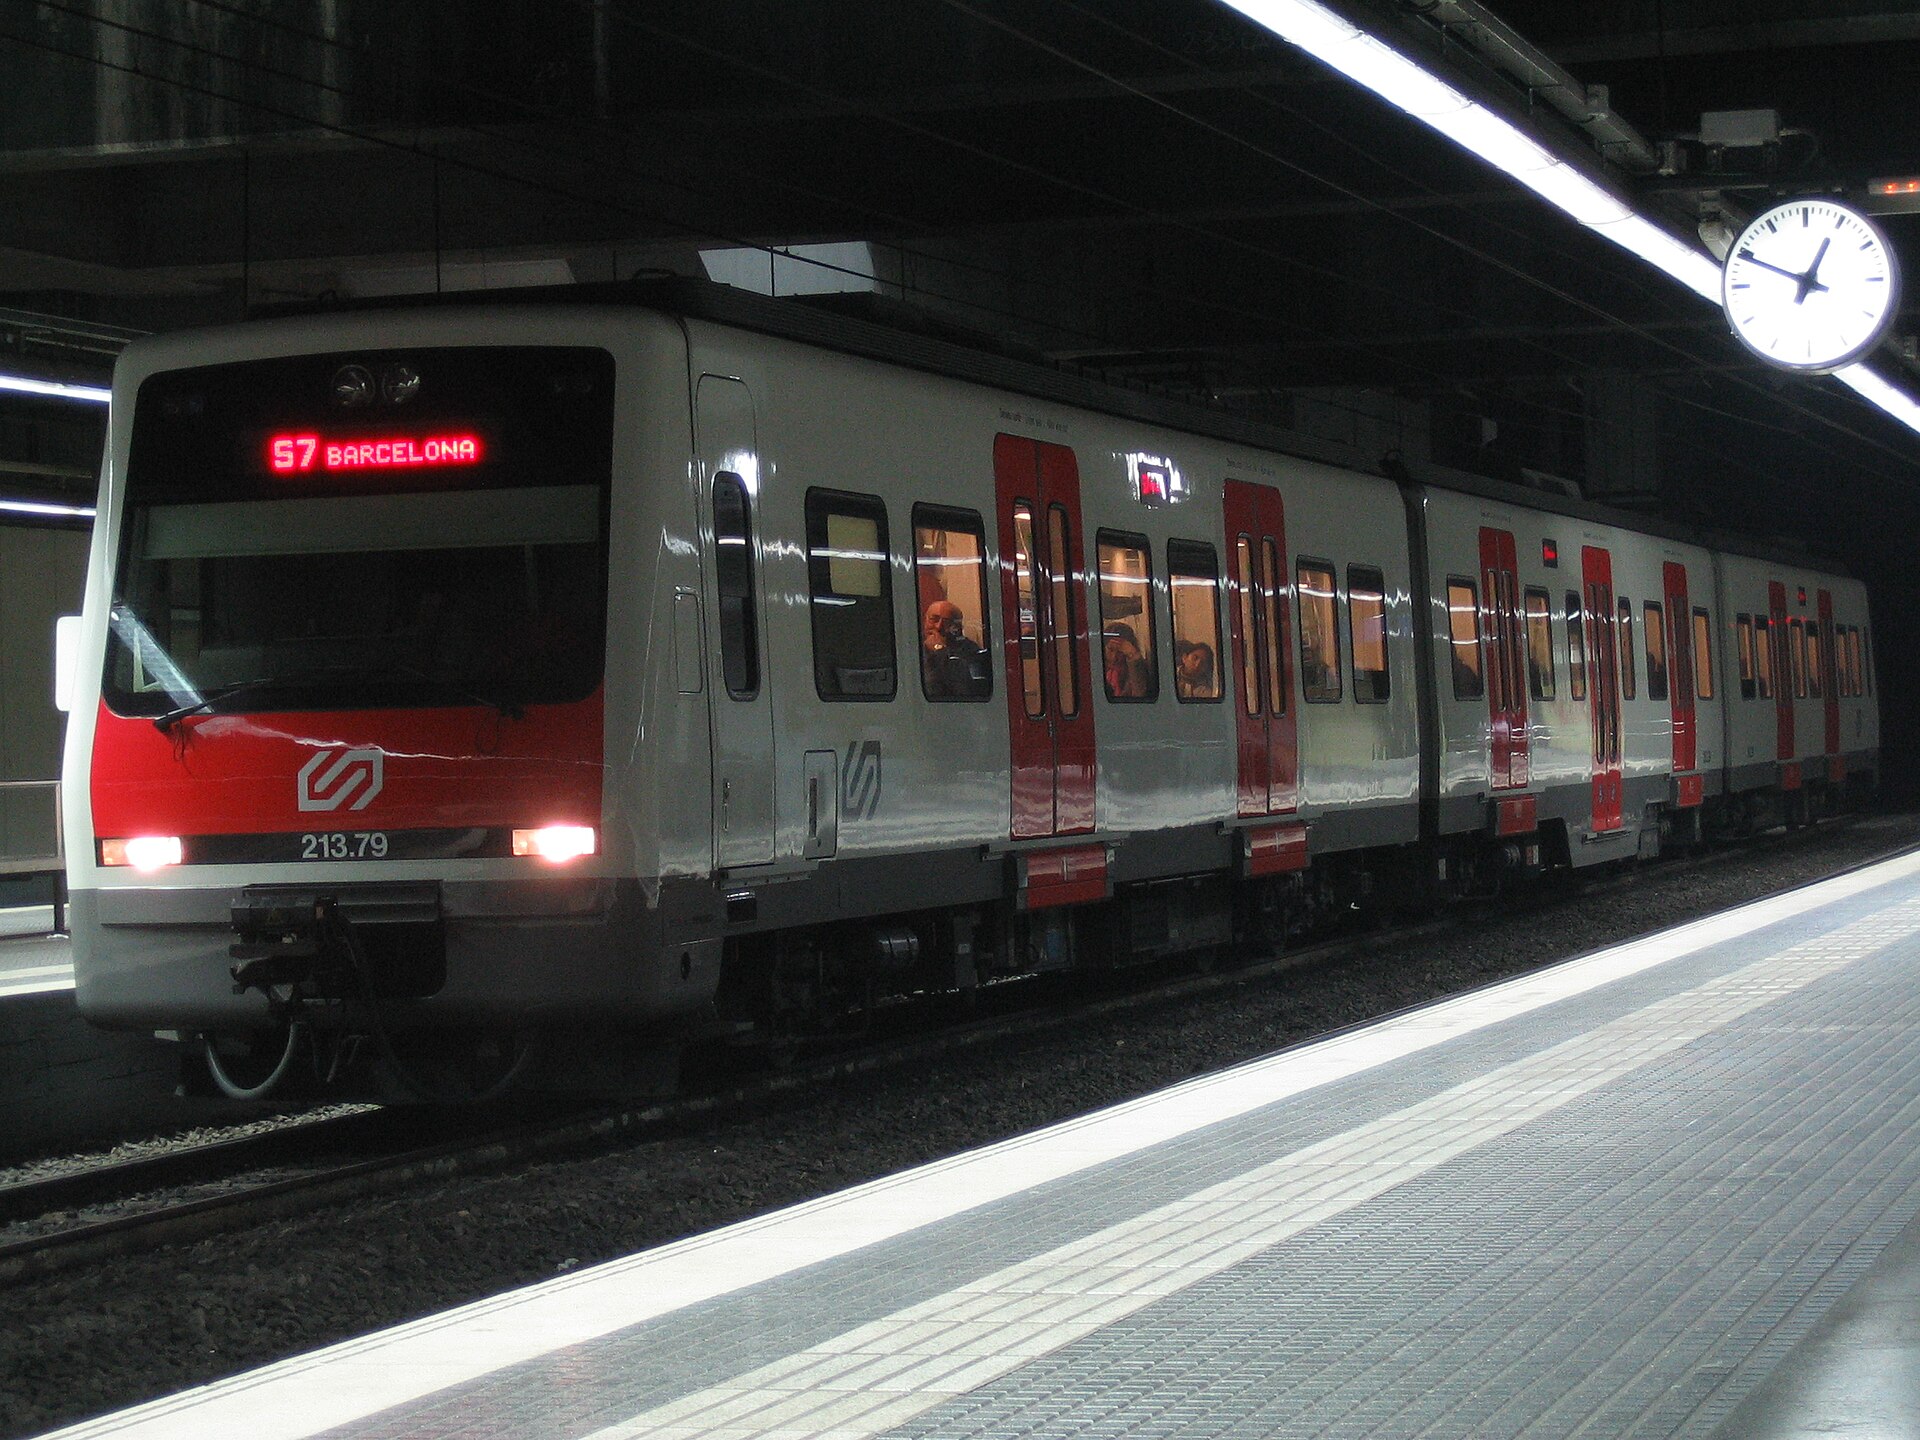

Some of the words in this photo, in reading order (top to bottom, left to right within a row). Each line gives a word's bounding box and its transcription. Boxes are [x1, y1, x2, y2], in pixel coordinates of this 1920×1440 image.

[273, 438, 317, 468] S7
[326, 439, 476, 466] BARCELONA
[301, 832, 389, 859] 213.79
